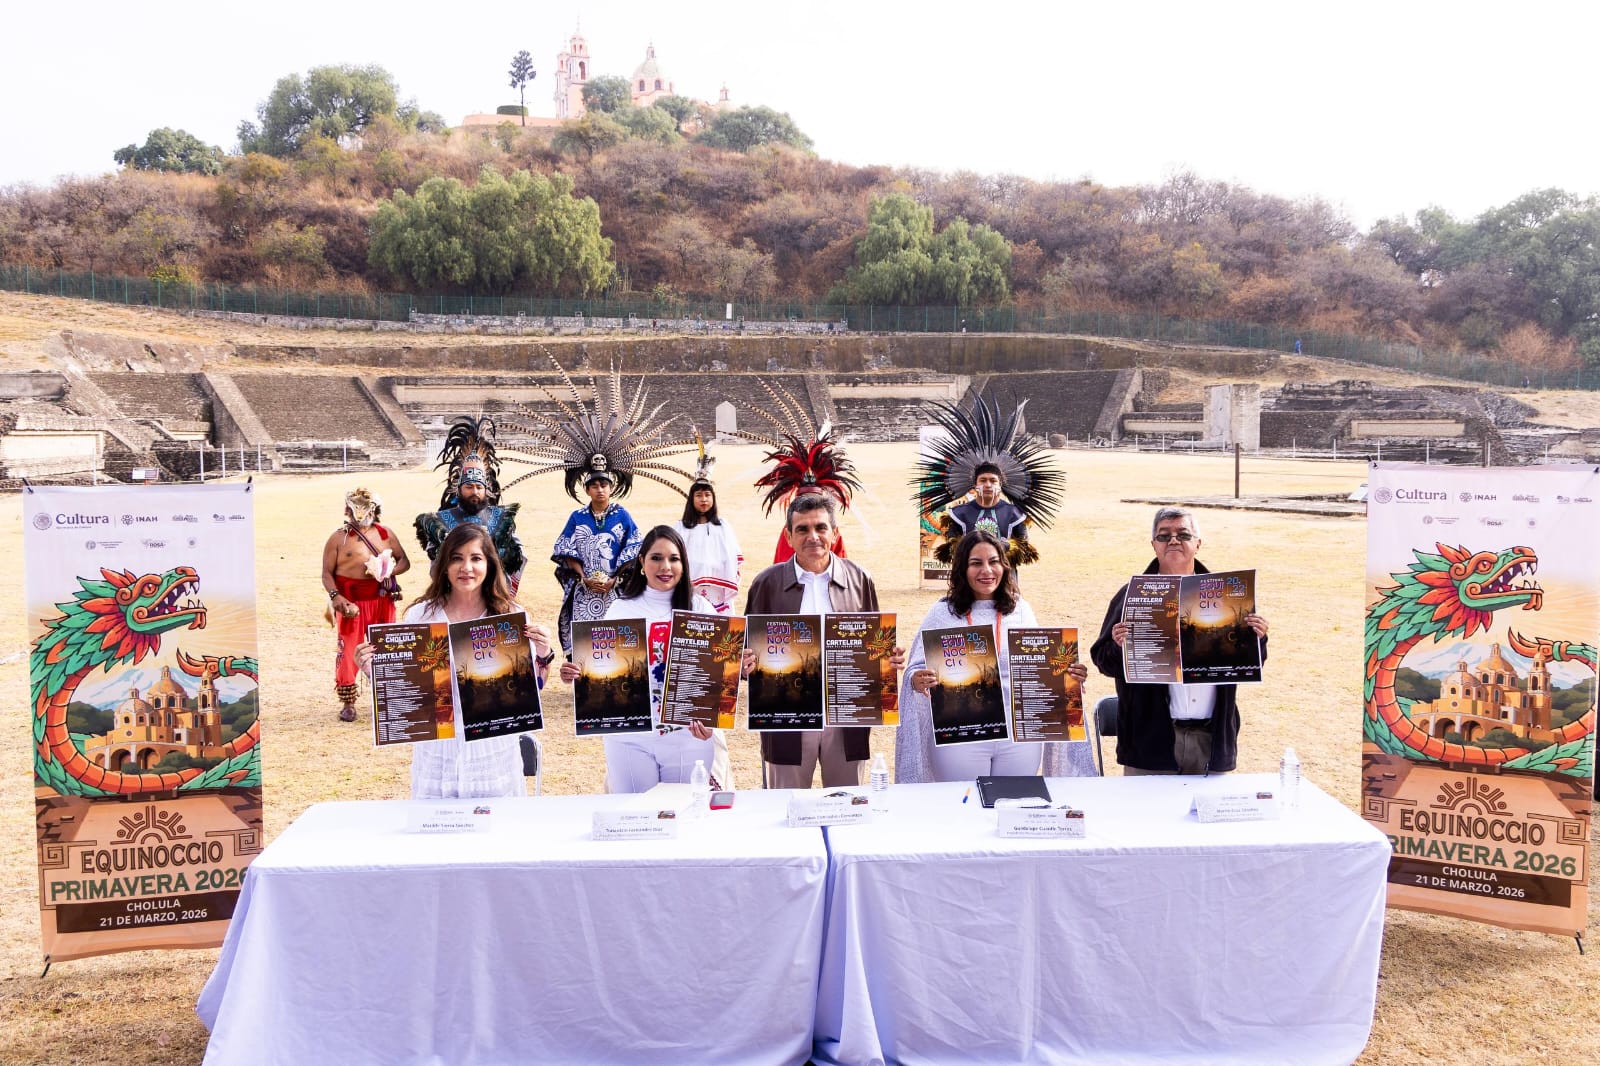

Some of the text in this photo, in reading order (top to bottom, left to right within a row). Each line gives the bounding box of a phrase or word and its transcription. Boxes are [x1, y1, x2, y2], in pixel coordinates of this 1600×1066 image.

[1396, 488, 1447, 500] Cultura
[56, 513, 110, 525] Cultura
[672, 636, 710, 646] CARTELERA
[374, 652, 412, 660] CARTELERA
[1400, 808, 1546, 846] EQUINOCCIO
[81, 840, 224, 876] EQUINOCCIO
[1386, 834, 1576, 876] RIMAVERA 2026
[1442, 866, 1498, 882] CHOLULA
[50, 873, 190, 901] PRIMAVERA
[1416, 874, 1526, 898] 21 DE MARZO, 2026
[126, 900, 181, 912] CHOLULA
[100, 909, 208, 927] 21 DE MARZO, 2026
